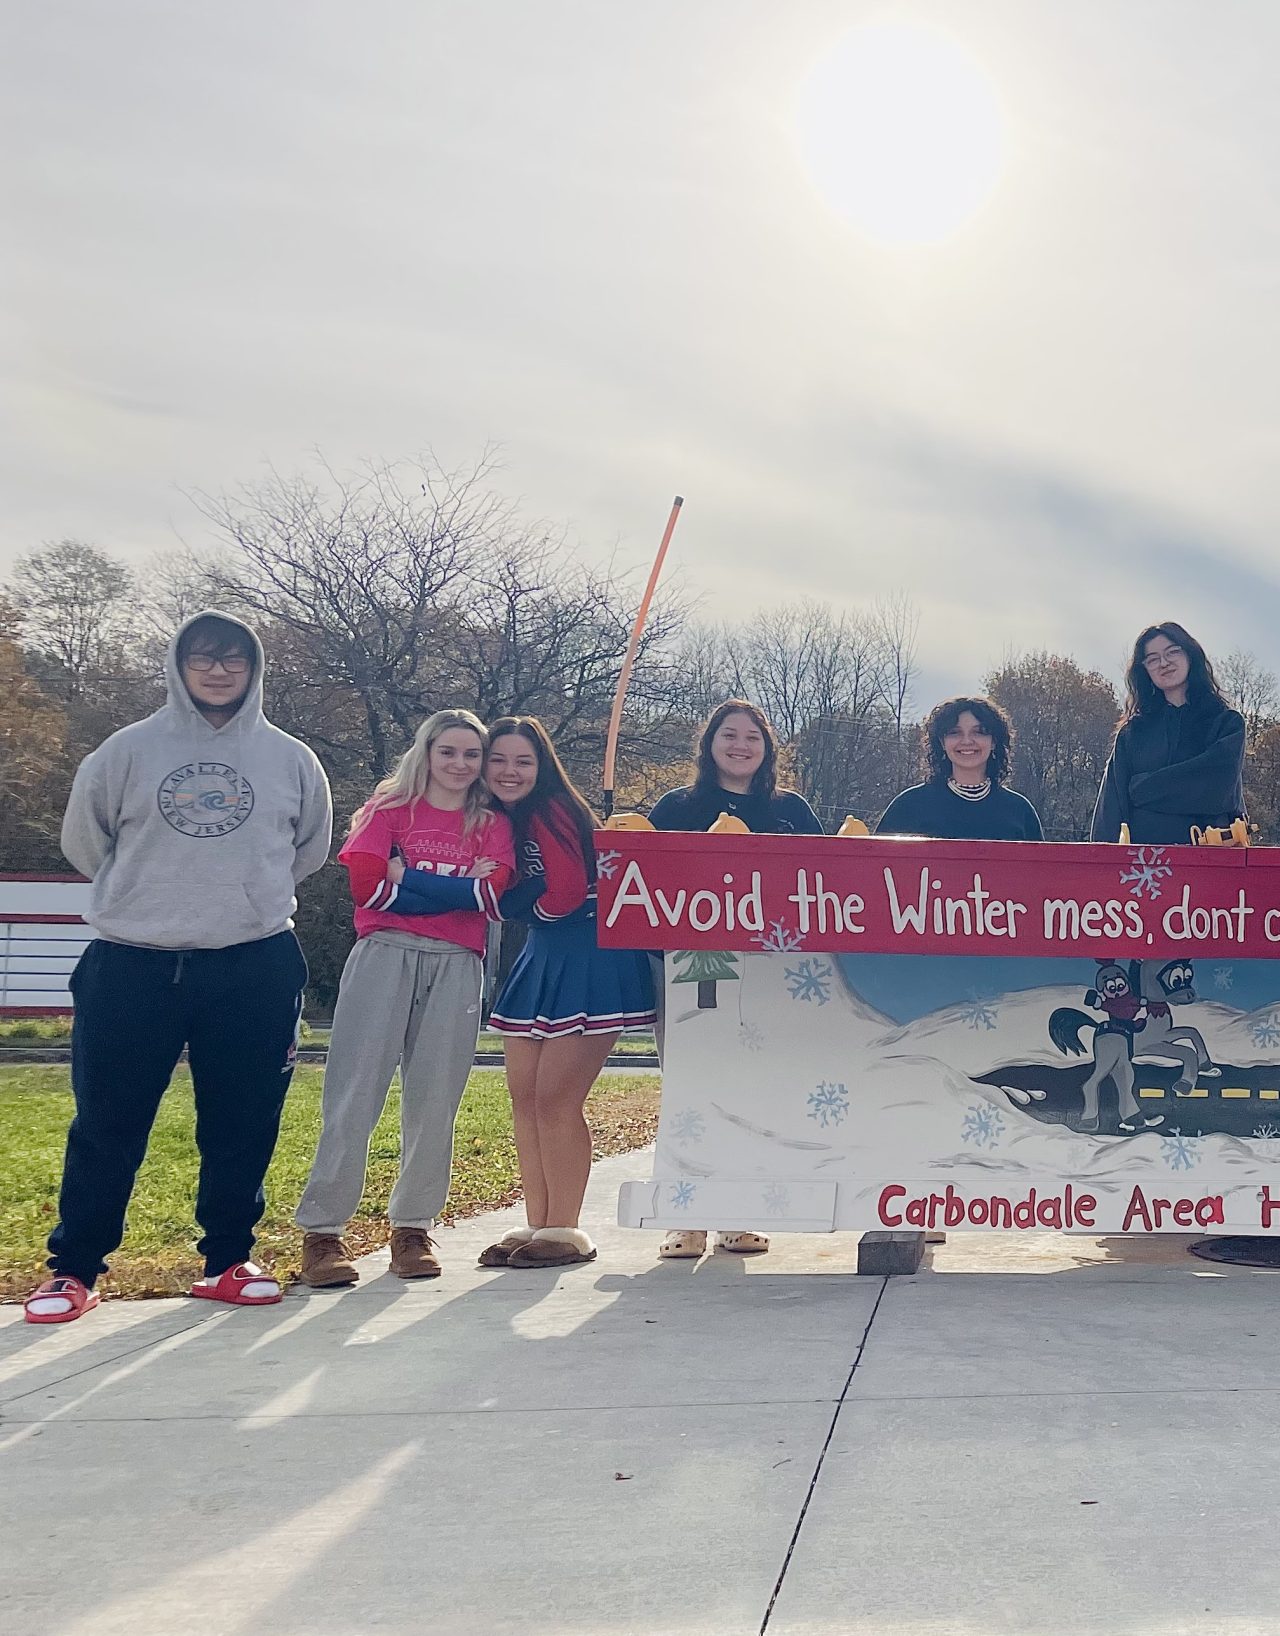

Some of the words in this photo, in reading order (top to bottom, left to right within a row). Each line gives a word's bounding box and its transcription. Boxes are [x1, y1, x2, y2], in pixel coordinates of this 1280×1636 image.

[194, 803, 250, 837] JERSEY
[606, 861, 764, 931] Avoid
[789, 869, 864, 933] the
[884, 867, 1027, 937] Winter
[1044, 898, 1153, 944] mess,
[1163, 885, 1254, 942] dont
[878, 1185, 1096, 1228] Carbondale
[1123, 1185, 1224, 1230] Area
